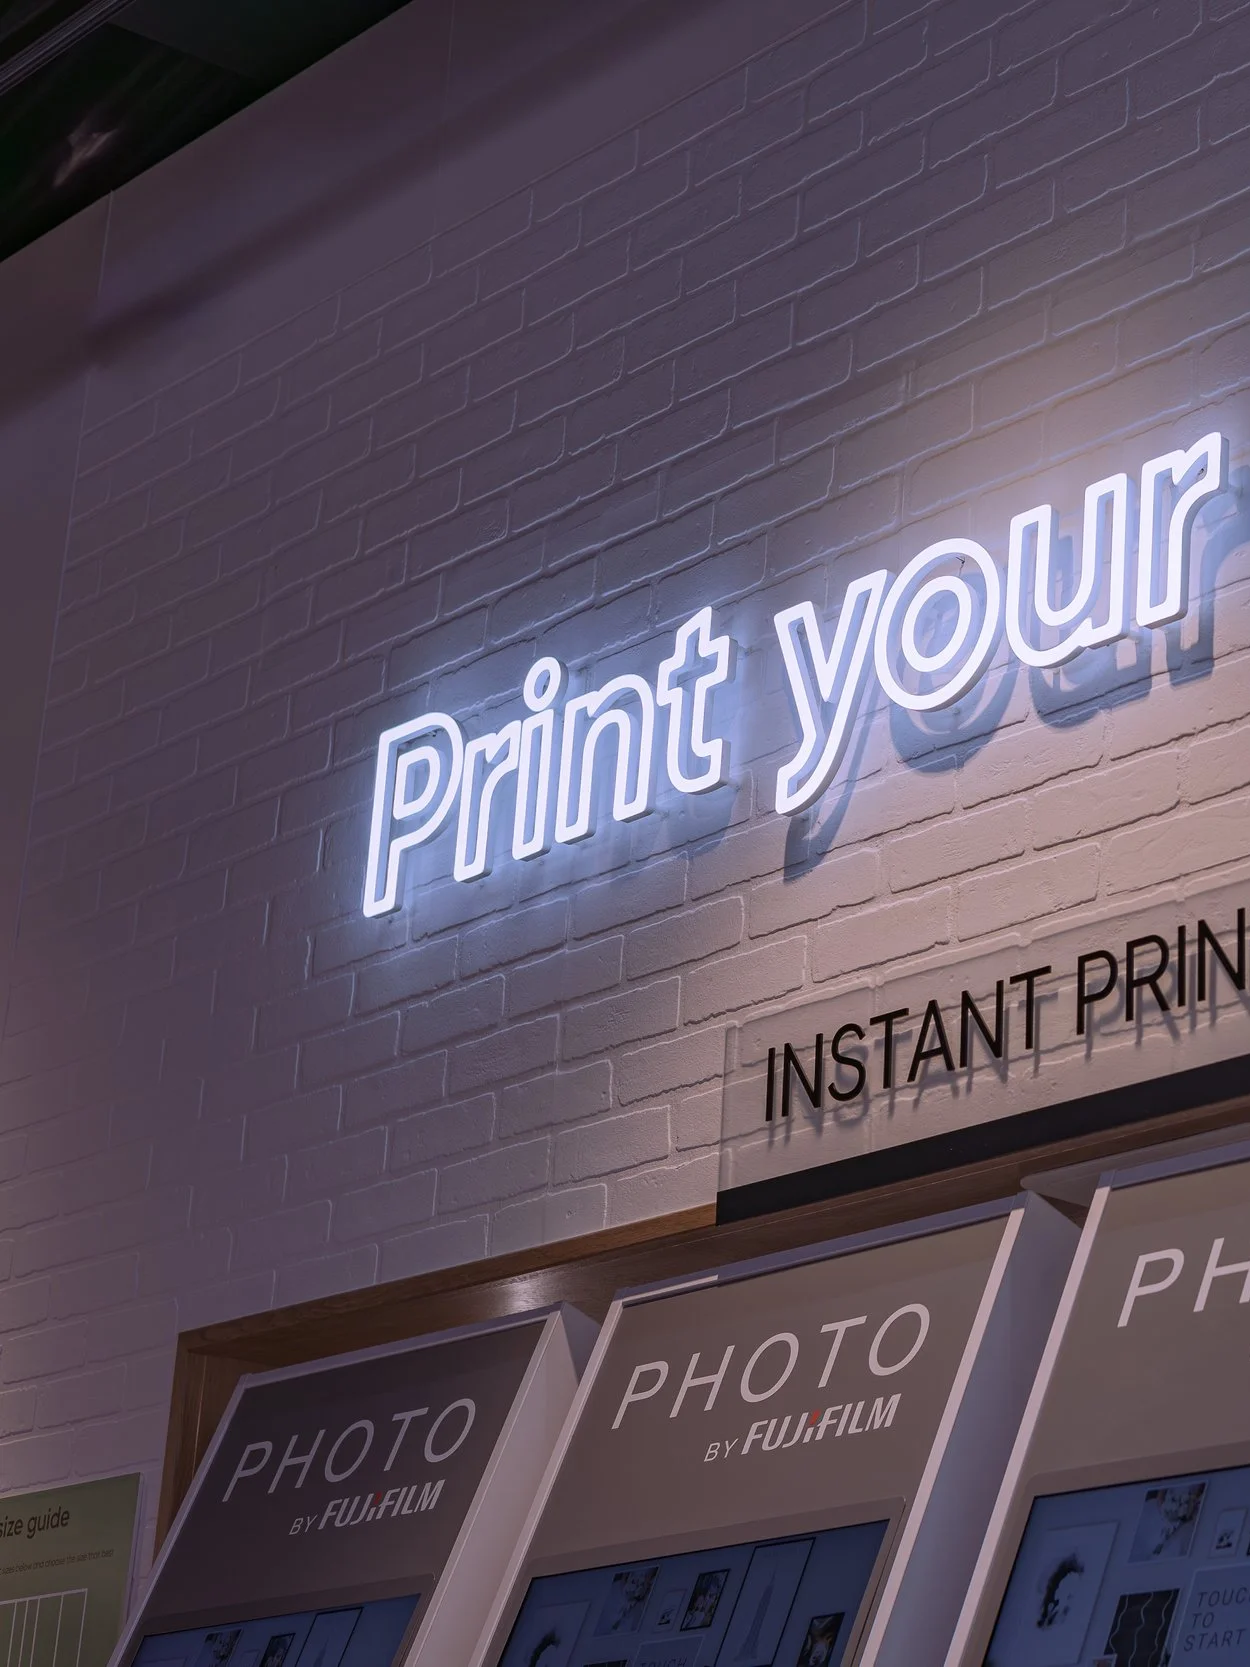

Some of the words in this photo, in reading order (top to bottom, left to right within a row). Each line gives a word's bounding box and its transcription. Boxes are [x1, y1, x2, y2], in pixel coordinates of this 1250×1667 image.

[363, 605, 732, 918] Print
[774, 431, 1222, 816] your
[764, 965, 1052, 1122] INSTANT
[611, 1303, 931, 1429] PHOTO
[222, 1398, 477, 1502] PHOTO
[704, 1441, 738, 1462] BY
[741, 1393, 901, 1455] FUJIFILM
[27, 1505, 70, 1539] guide
[289, 1515, 317, 1535] BY
[318, 1480, 445, 1530] FUJIFILM
[33, 1560, 45, 1570] and
[66, 1555, 76, 1564] the
[1183, 1628, 1247, 1652] START
[1192, 1612, 1215, 1629] TO
